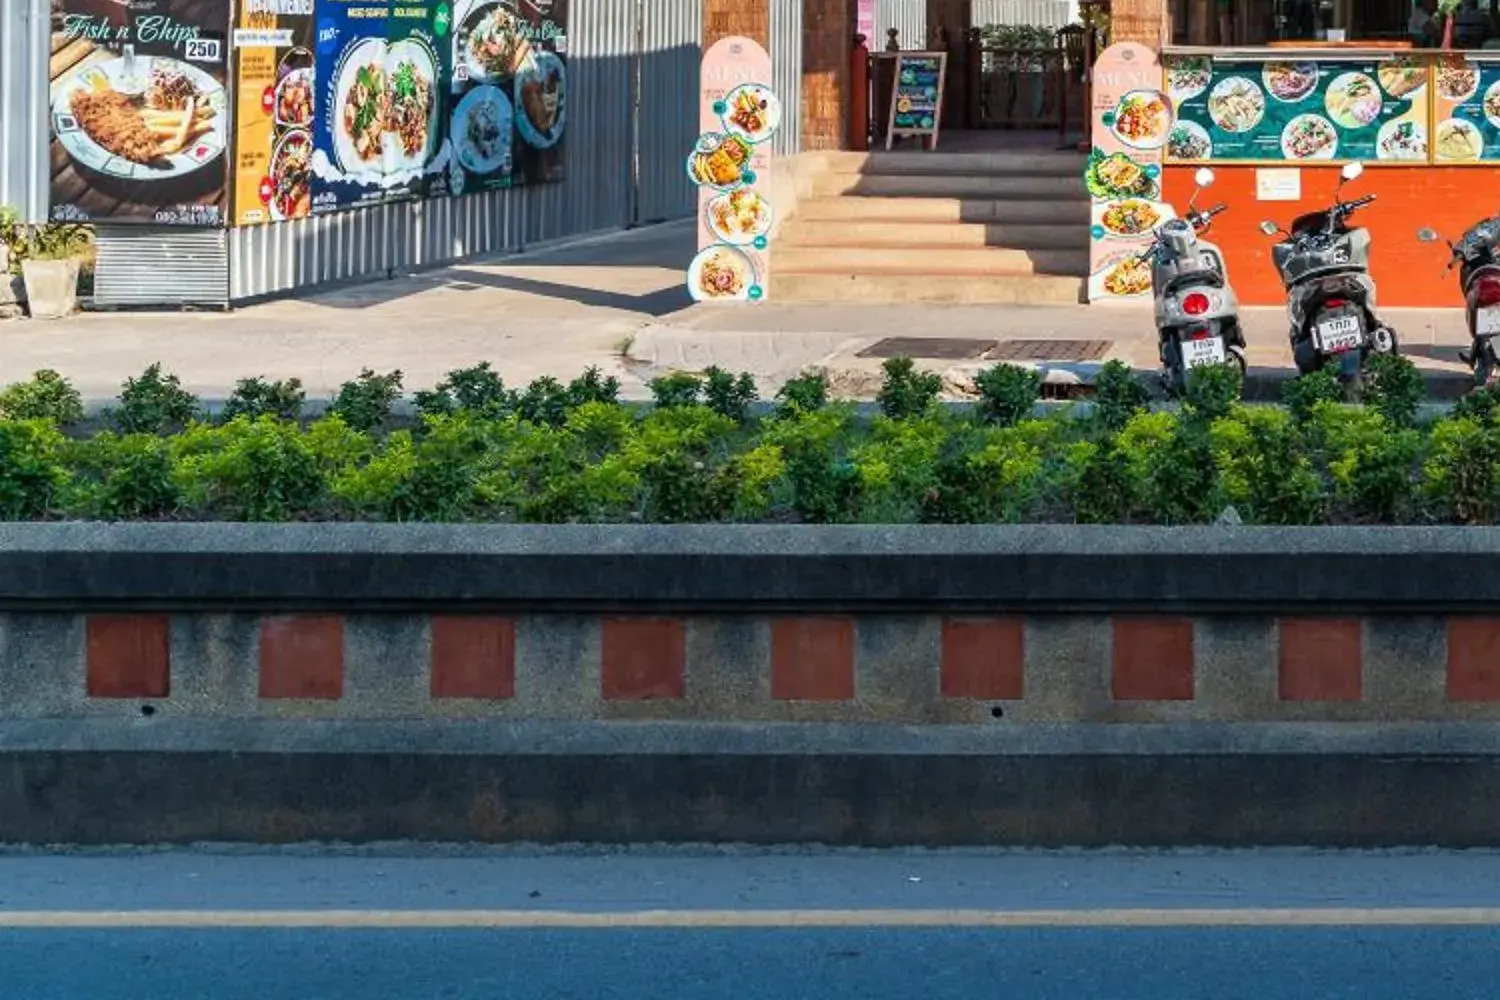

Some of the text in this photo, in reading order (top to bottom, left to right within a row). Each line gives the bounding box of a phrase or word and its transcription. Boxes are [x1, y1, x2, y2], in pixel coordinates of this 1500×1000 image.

[62, 13, 199, 50] Fish n Chips
[188, 41, 218, 57] 250
